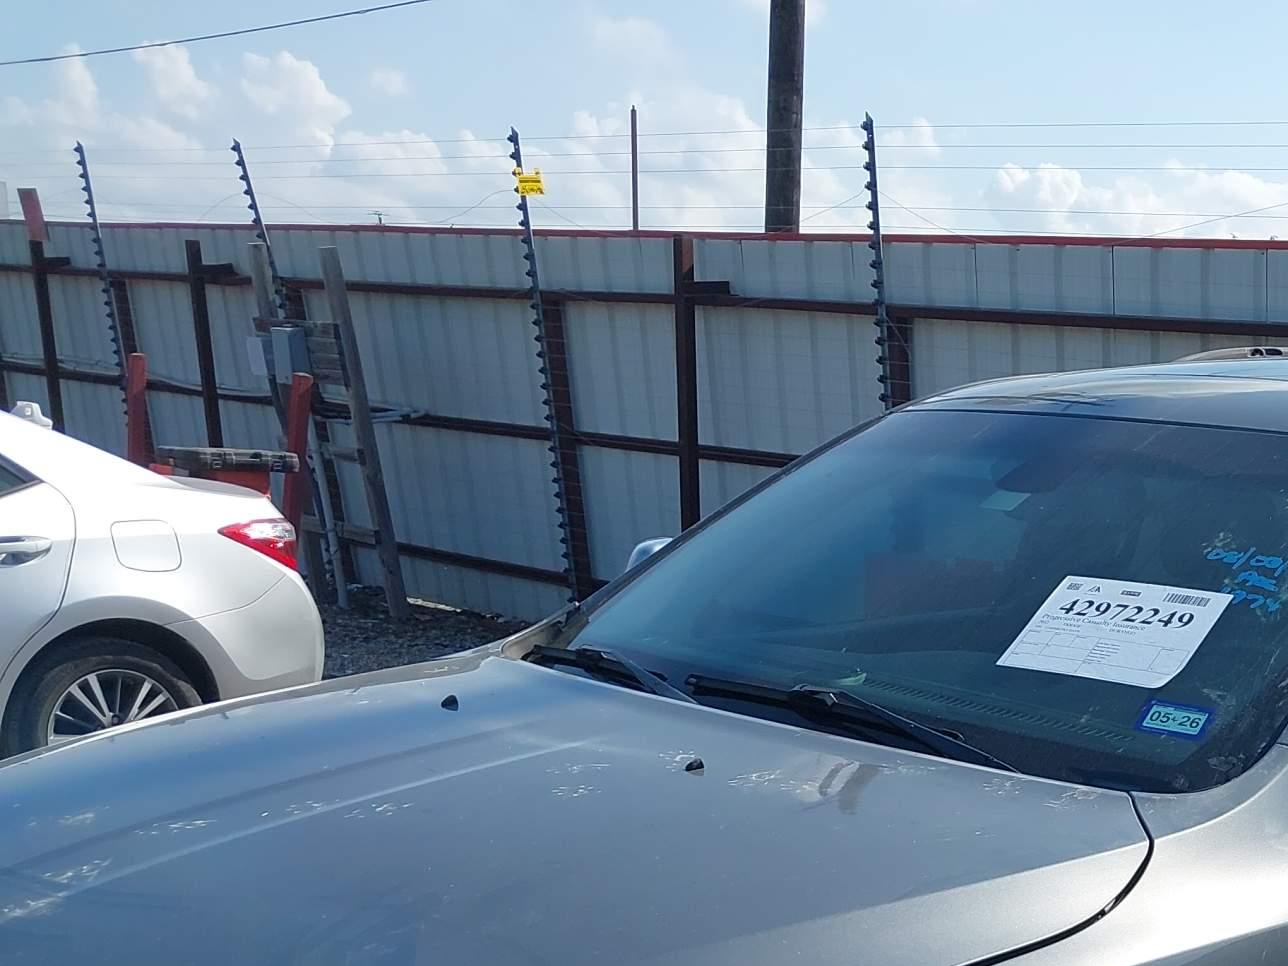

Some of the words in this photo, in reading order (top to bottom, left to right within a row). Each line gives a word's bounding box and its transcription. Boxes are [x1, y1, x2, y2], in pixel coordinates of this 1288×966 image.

[1042, 612, 1082, 625] Progressive
[1082, 617, 1111, 628] Casualty
[1112, 621, 1146, 632] Insurance
[1058, 598, 1195, 629] 42972249
